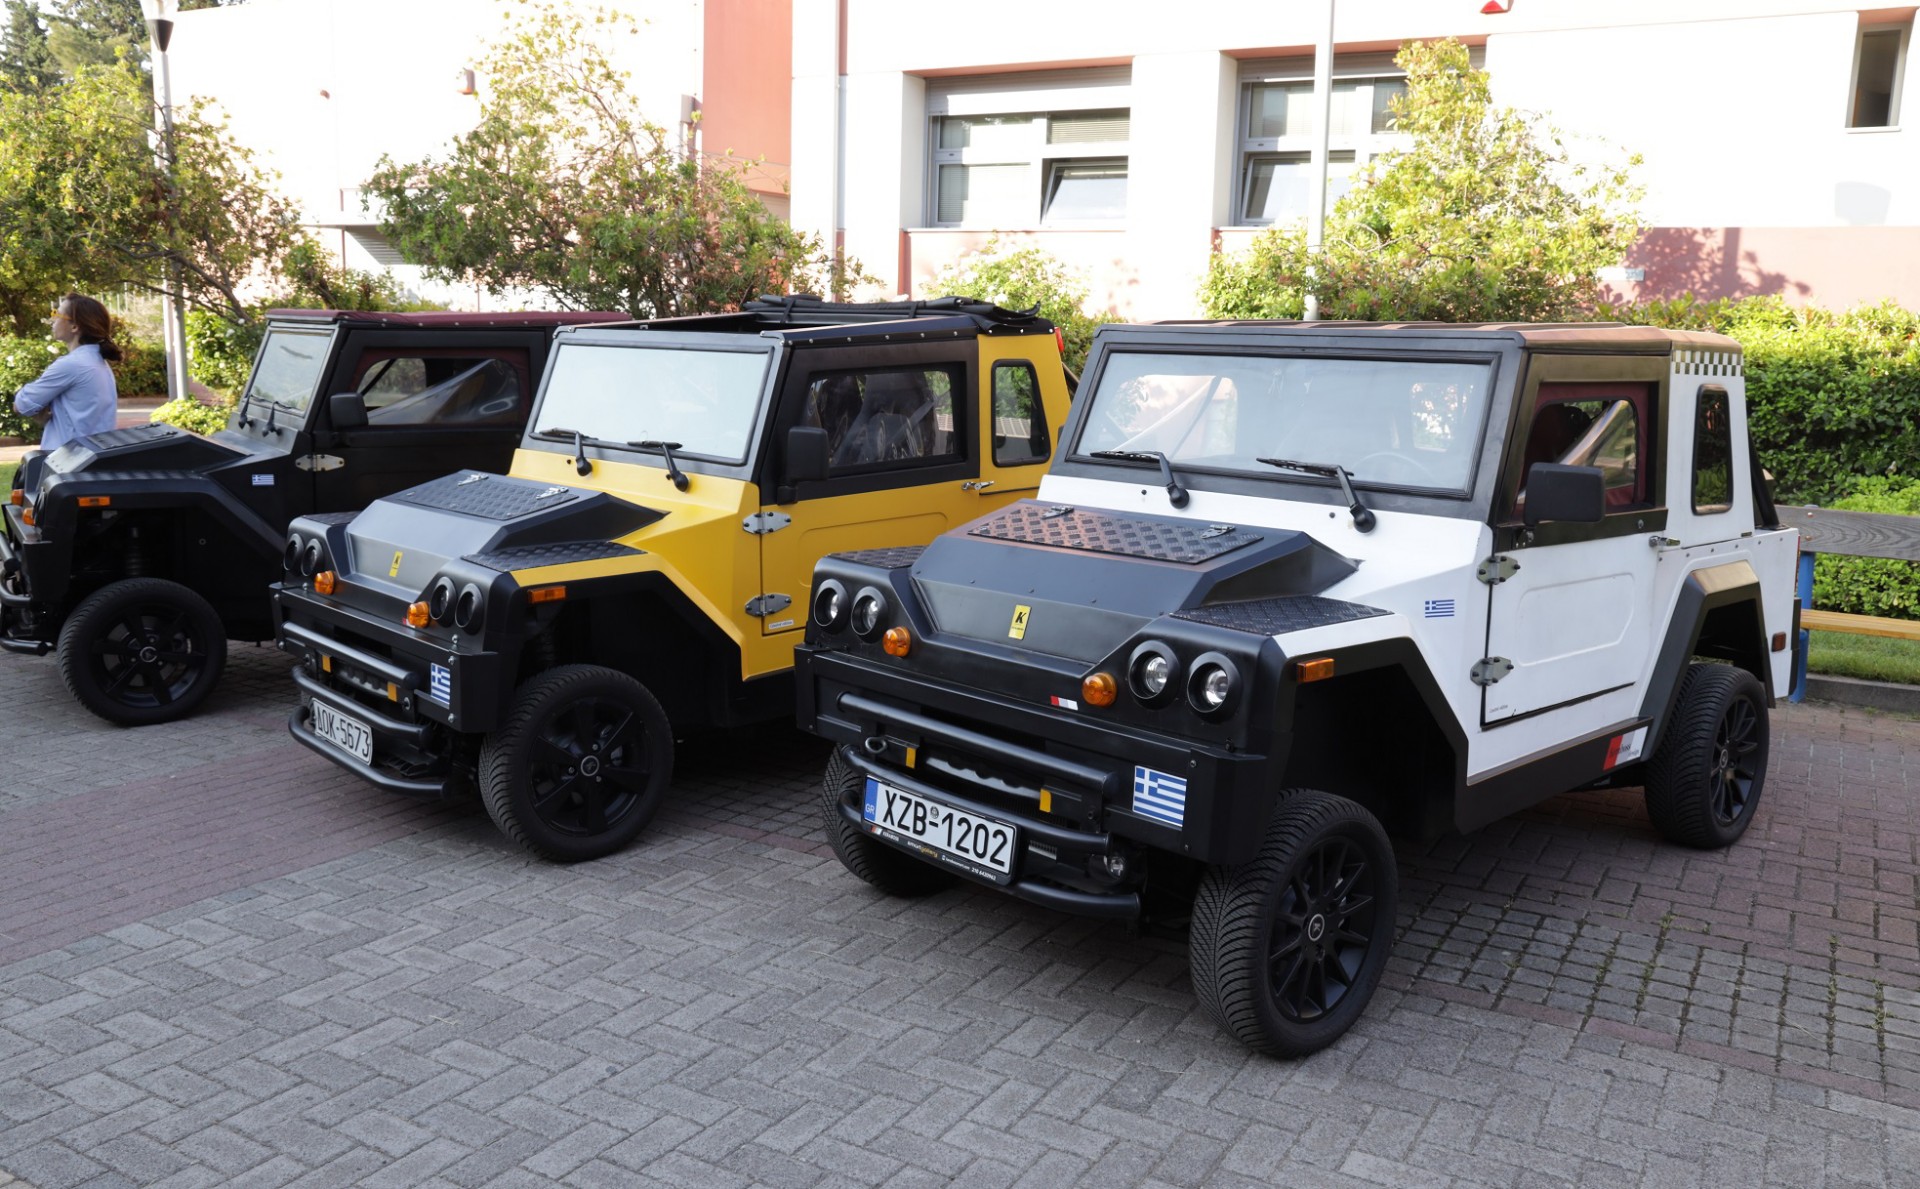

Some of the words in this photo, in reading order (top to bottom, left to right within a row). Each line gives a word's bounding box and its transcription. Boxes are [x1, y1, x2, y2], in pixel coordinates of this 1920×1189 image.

[1015, 611, 1027, 624] K
[865, 803, 875, 815] GR
[883, 789, 1008, 867] XZB-1202
